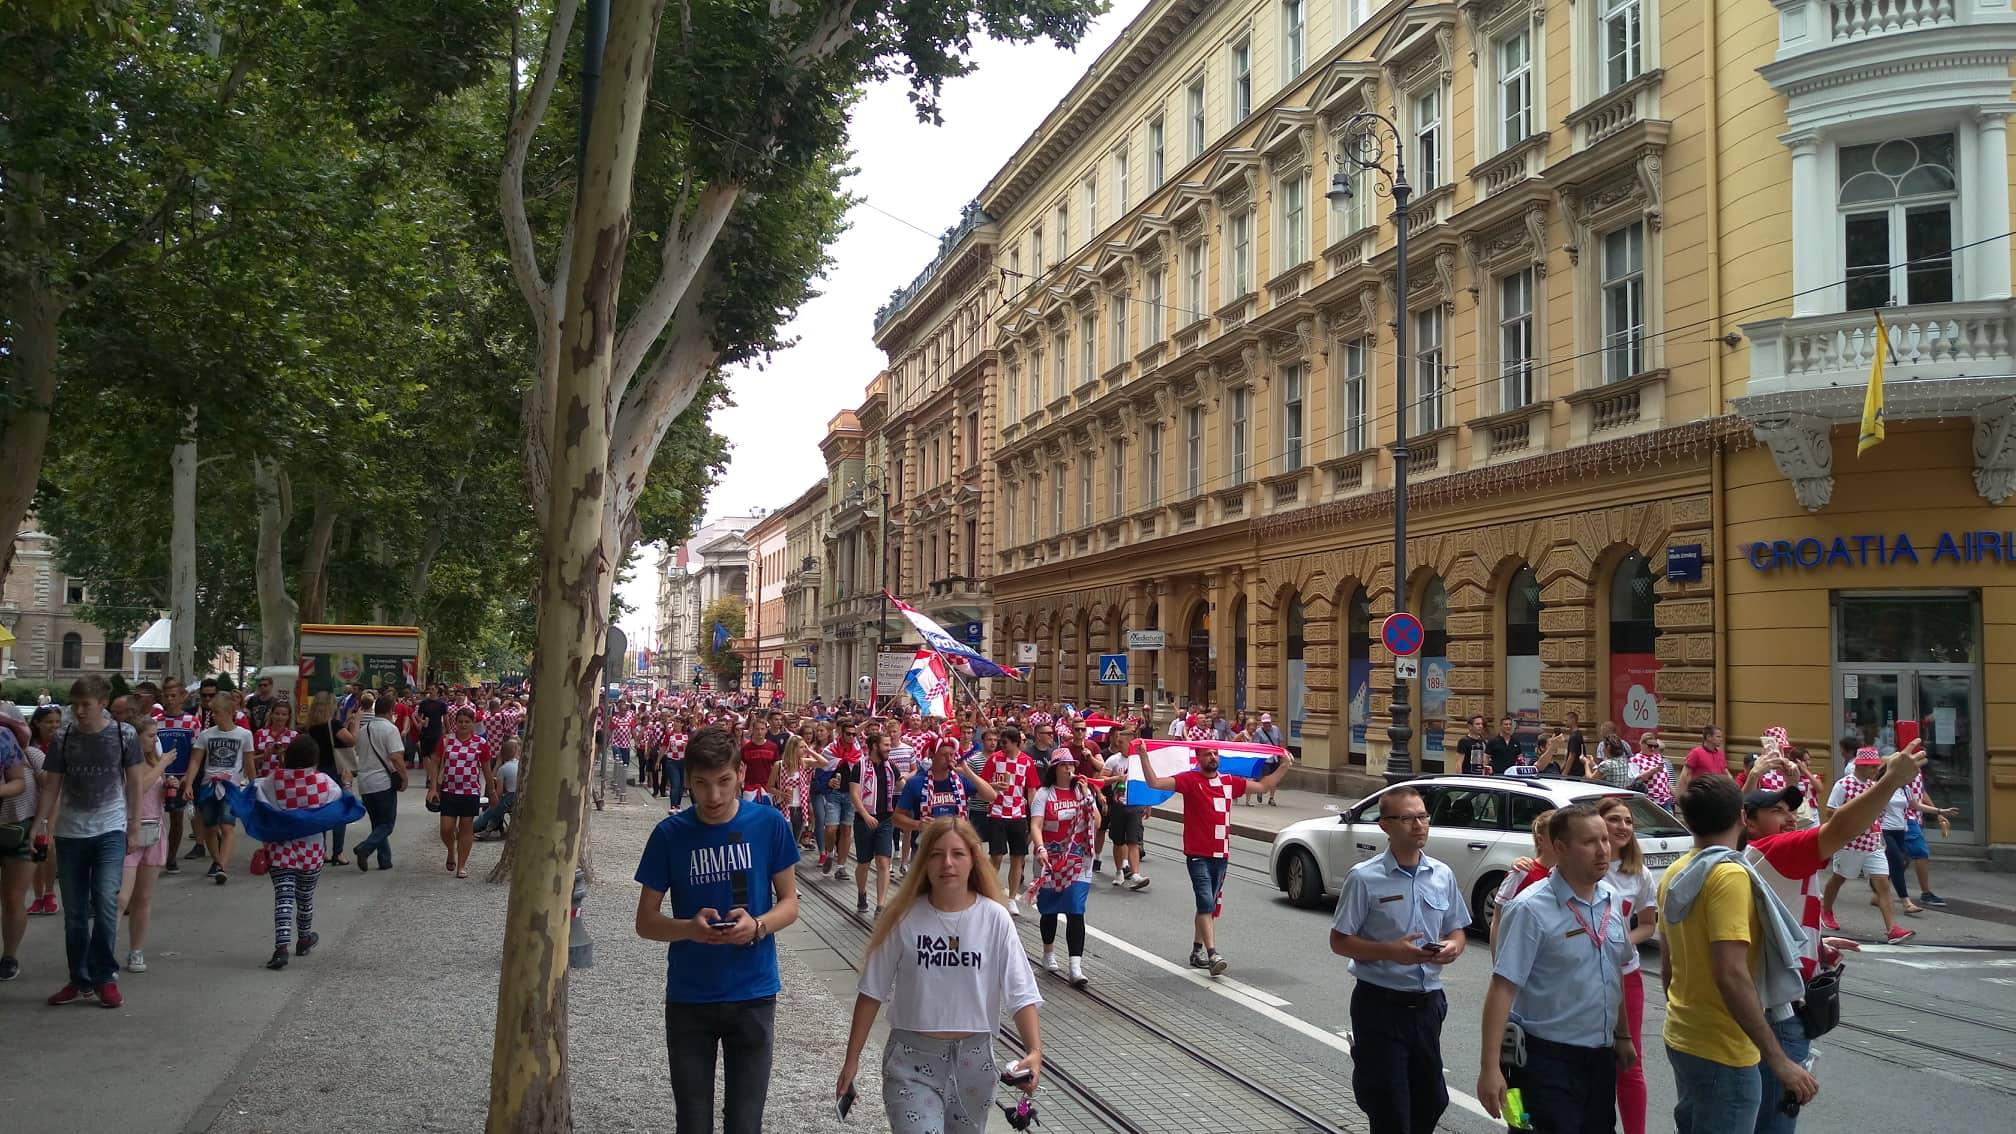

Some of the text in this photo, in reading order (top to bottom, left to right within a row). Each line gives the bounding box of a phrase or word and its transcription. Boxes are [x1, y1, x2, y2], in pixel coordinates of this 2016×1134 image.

[1749, 533, 1919, 572] CROATIA
[690, 842, 753, 877] ARMANI
[917, 934, 960, 954] IRON
[917, 951, 982, 970] MAIDEN
